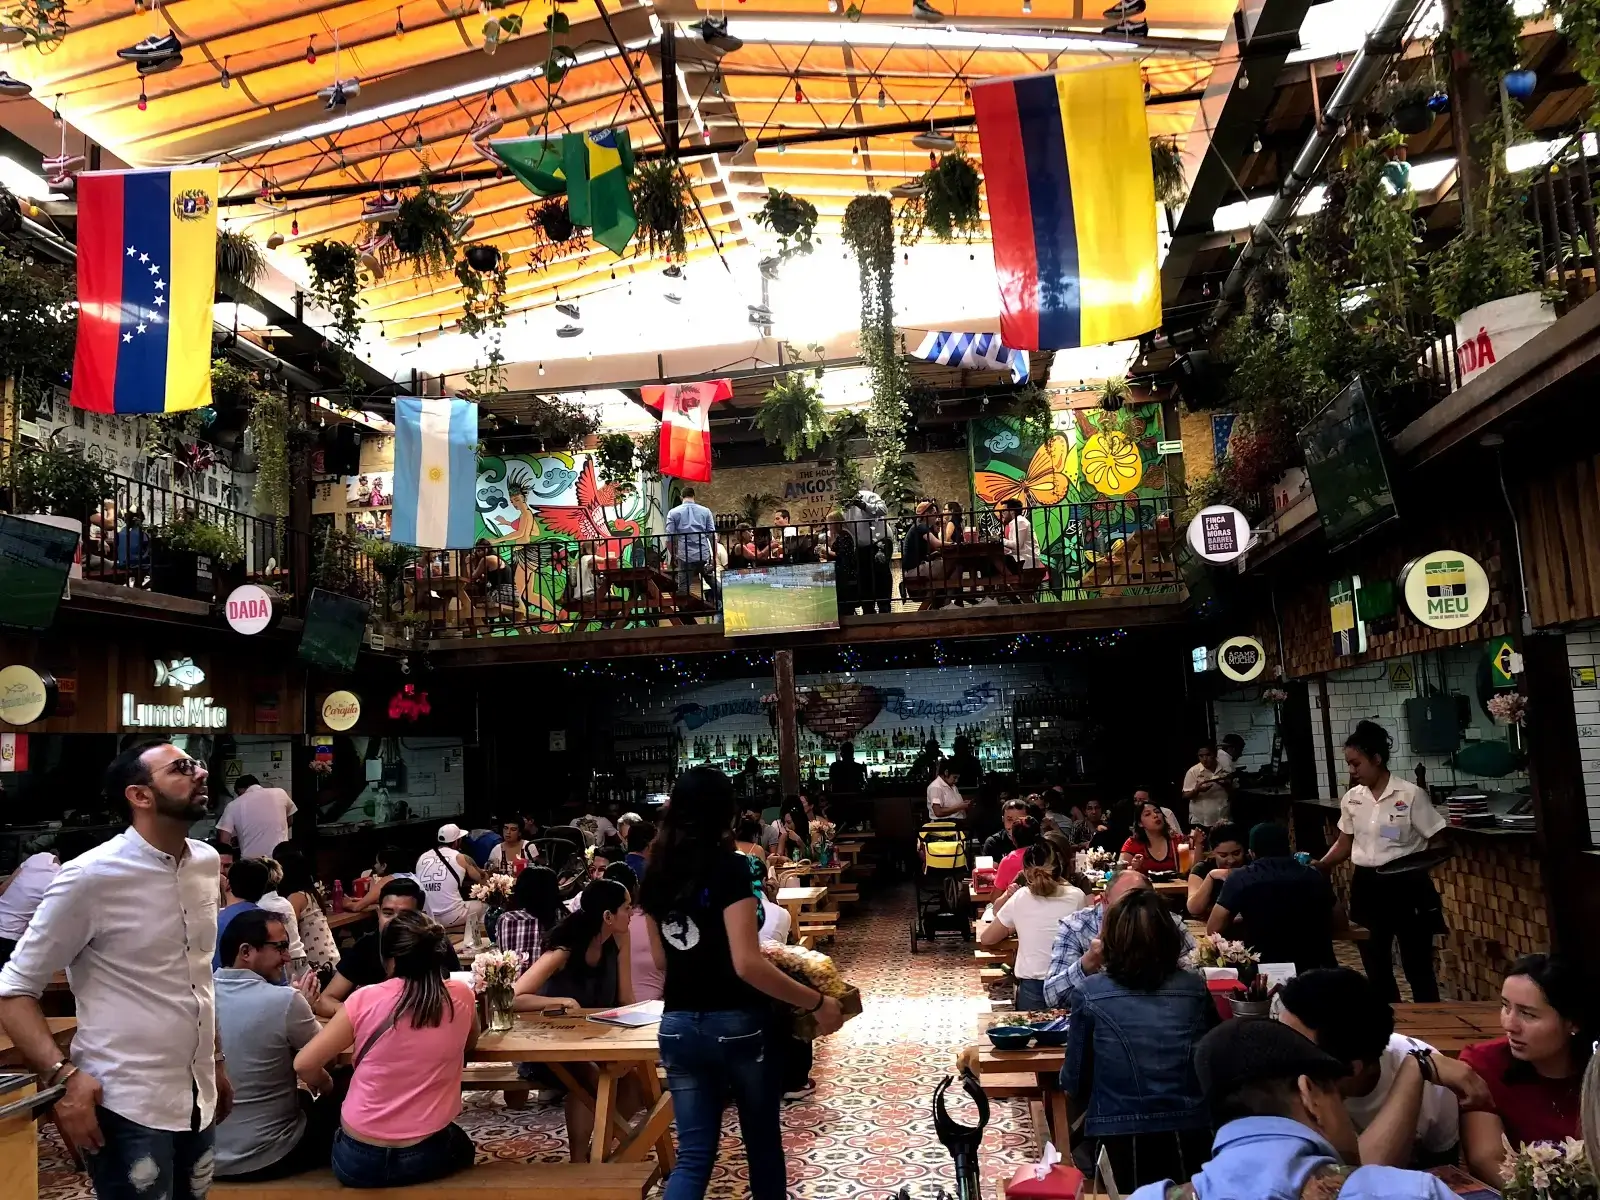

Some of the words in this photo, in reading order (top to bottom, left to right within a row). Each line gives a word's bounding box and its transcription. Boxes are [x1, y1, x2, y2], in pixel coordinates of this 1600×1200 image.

[799, 471, 814, 479] THE
[784, 476, 838, 499] ANGOS
[811, 495, 826, 503] EST.
[1205, 516, 1226, 525] FINCA
[1206, 523, 1219, 531] LAS
[1207, 529, 1231, 537] MORAS
[1207, 536, 1233, 544] BARREL
[1208, 542, 1233, 551] SELECT
[1427, 597, 1469, 614] MEU
[1228, 656, 1256, 665] MUCHO
[420, 855, 450, 883] 23
[423, 882, 442, 892] AMES
